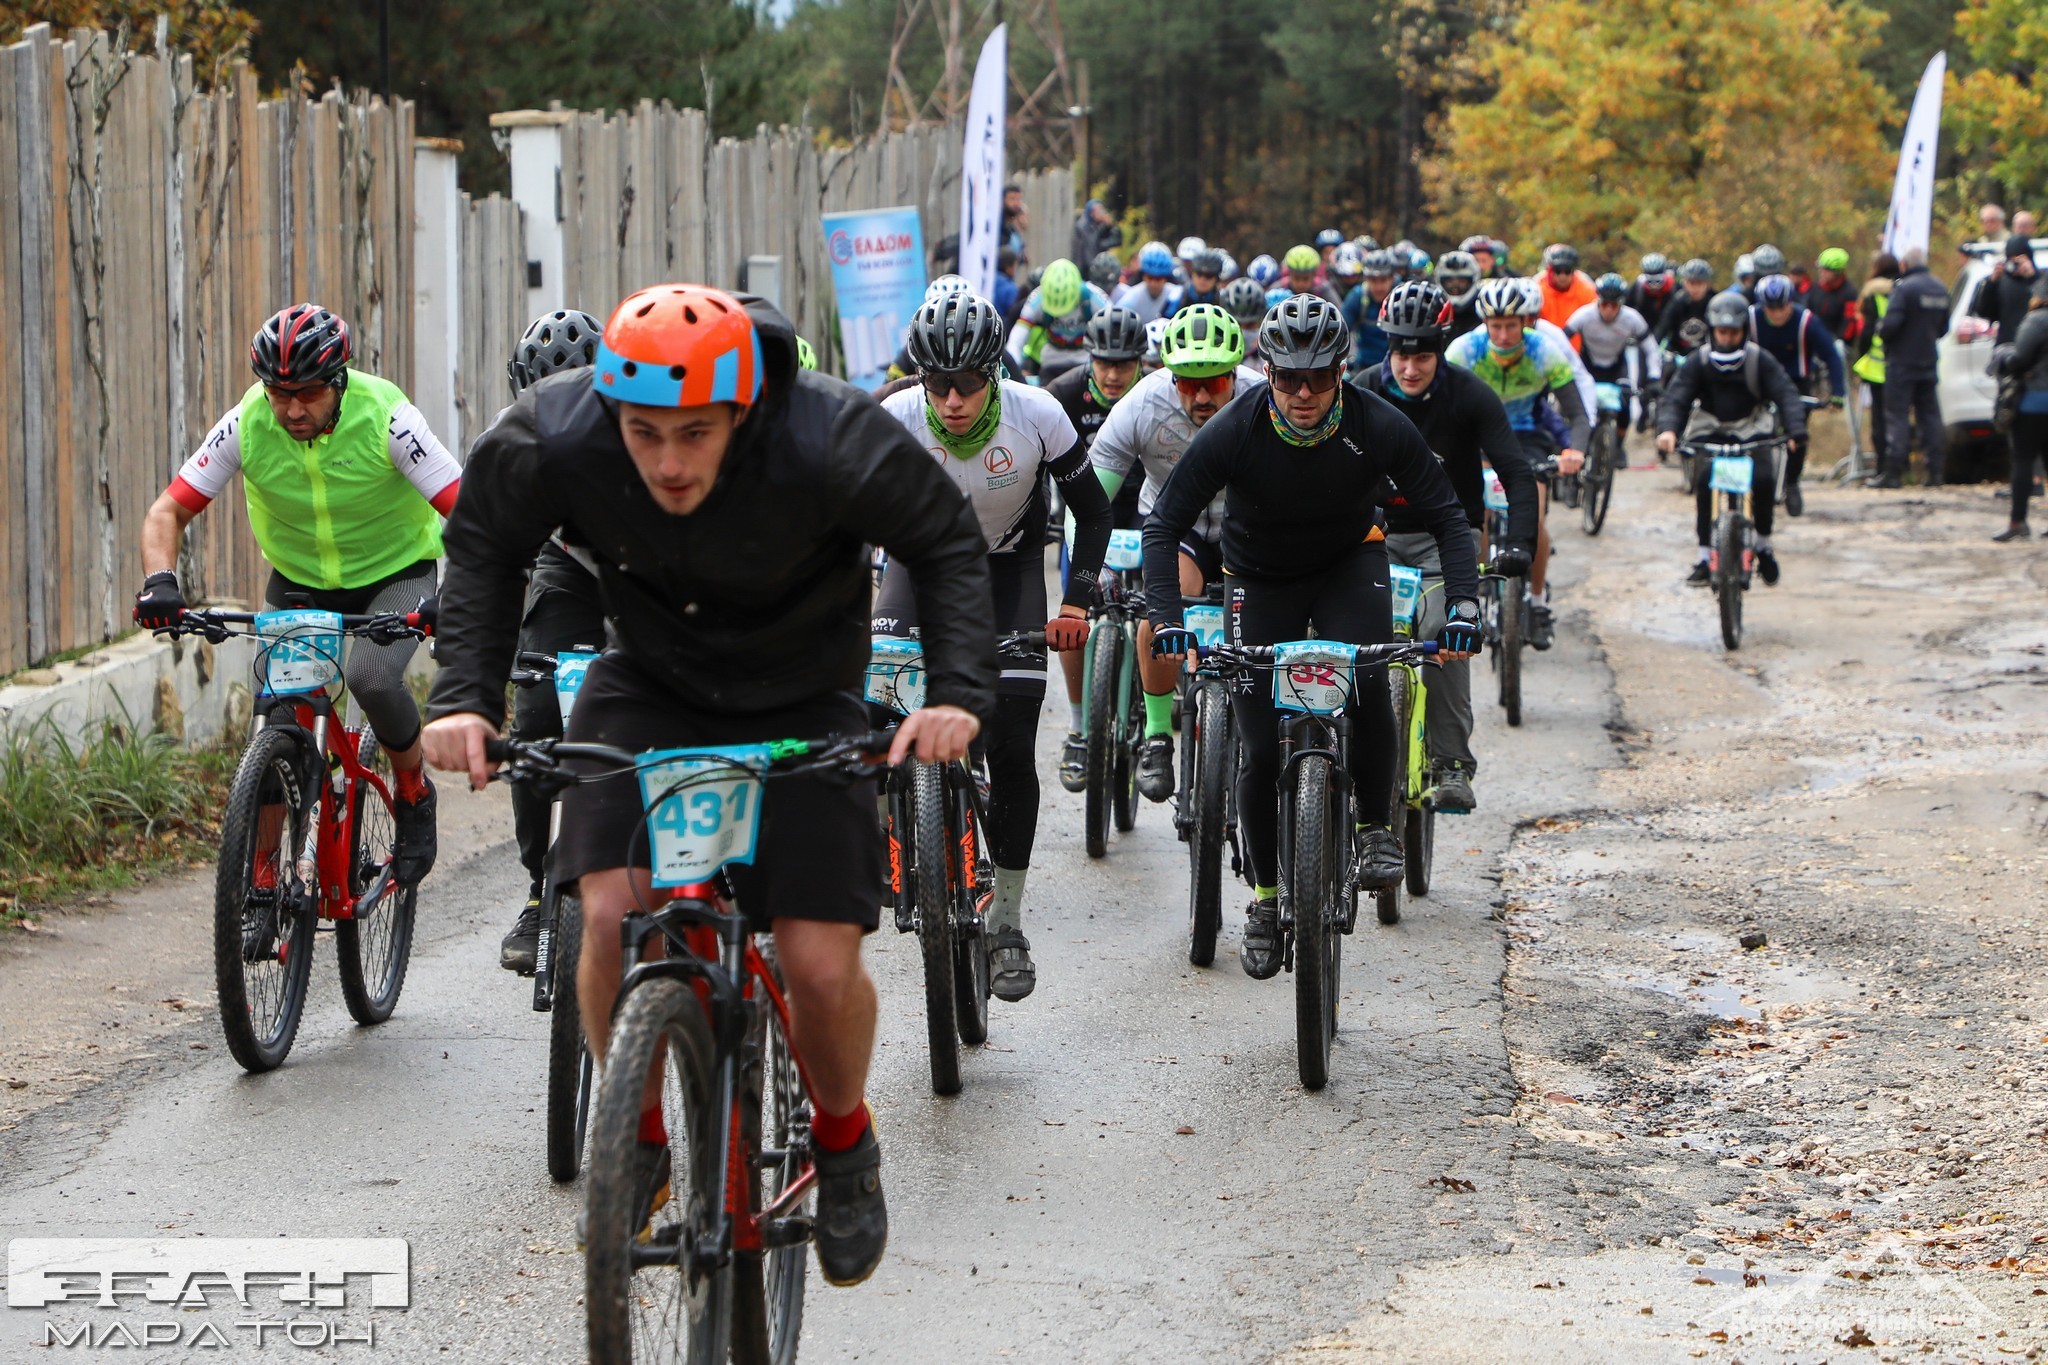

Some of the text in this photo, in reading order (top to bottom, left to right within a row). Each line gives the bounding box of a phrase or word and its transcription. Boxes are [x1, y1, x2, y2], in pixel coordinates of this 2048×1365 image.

[855, 234, 913, 255] ЕЛДОМ
[987, 474, 1018, 488] Варна
[270, 634, 338, 664] 428
[559, 669, 587, 699] 4
[872, 660, 928, 688] 41
[1291, 661, 1336, 687] 32
[654, 782, 750, 839] 431
